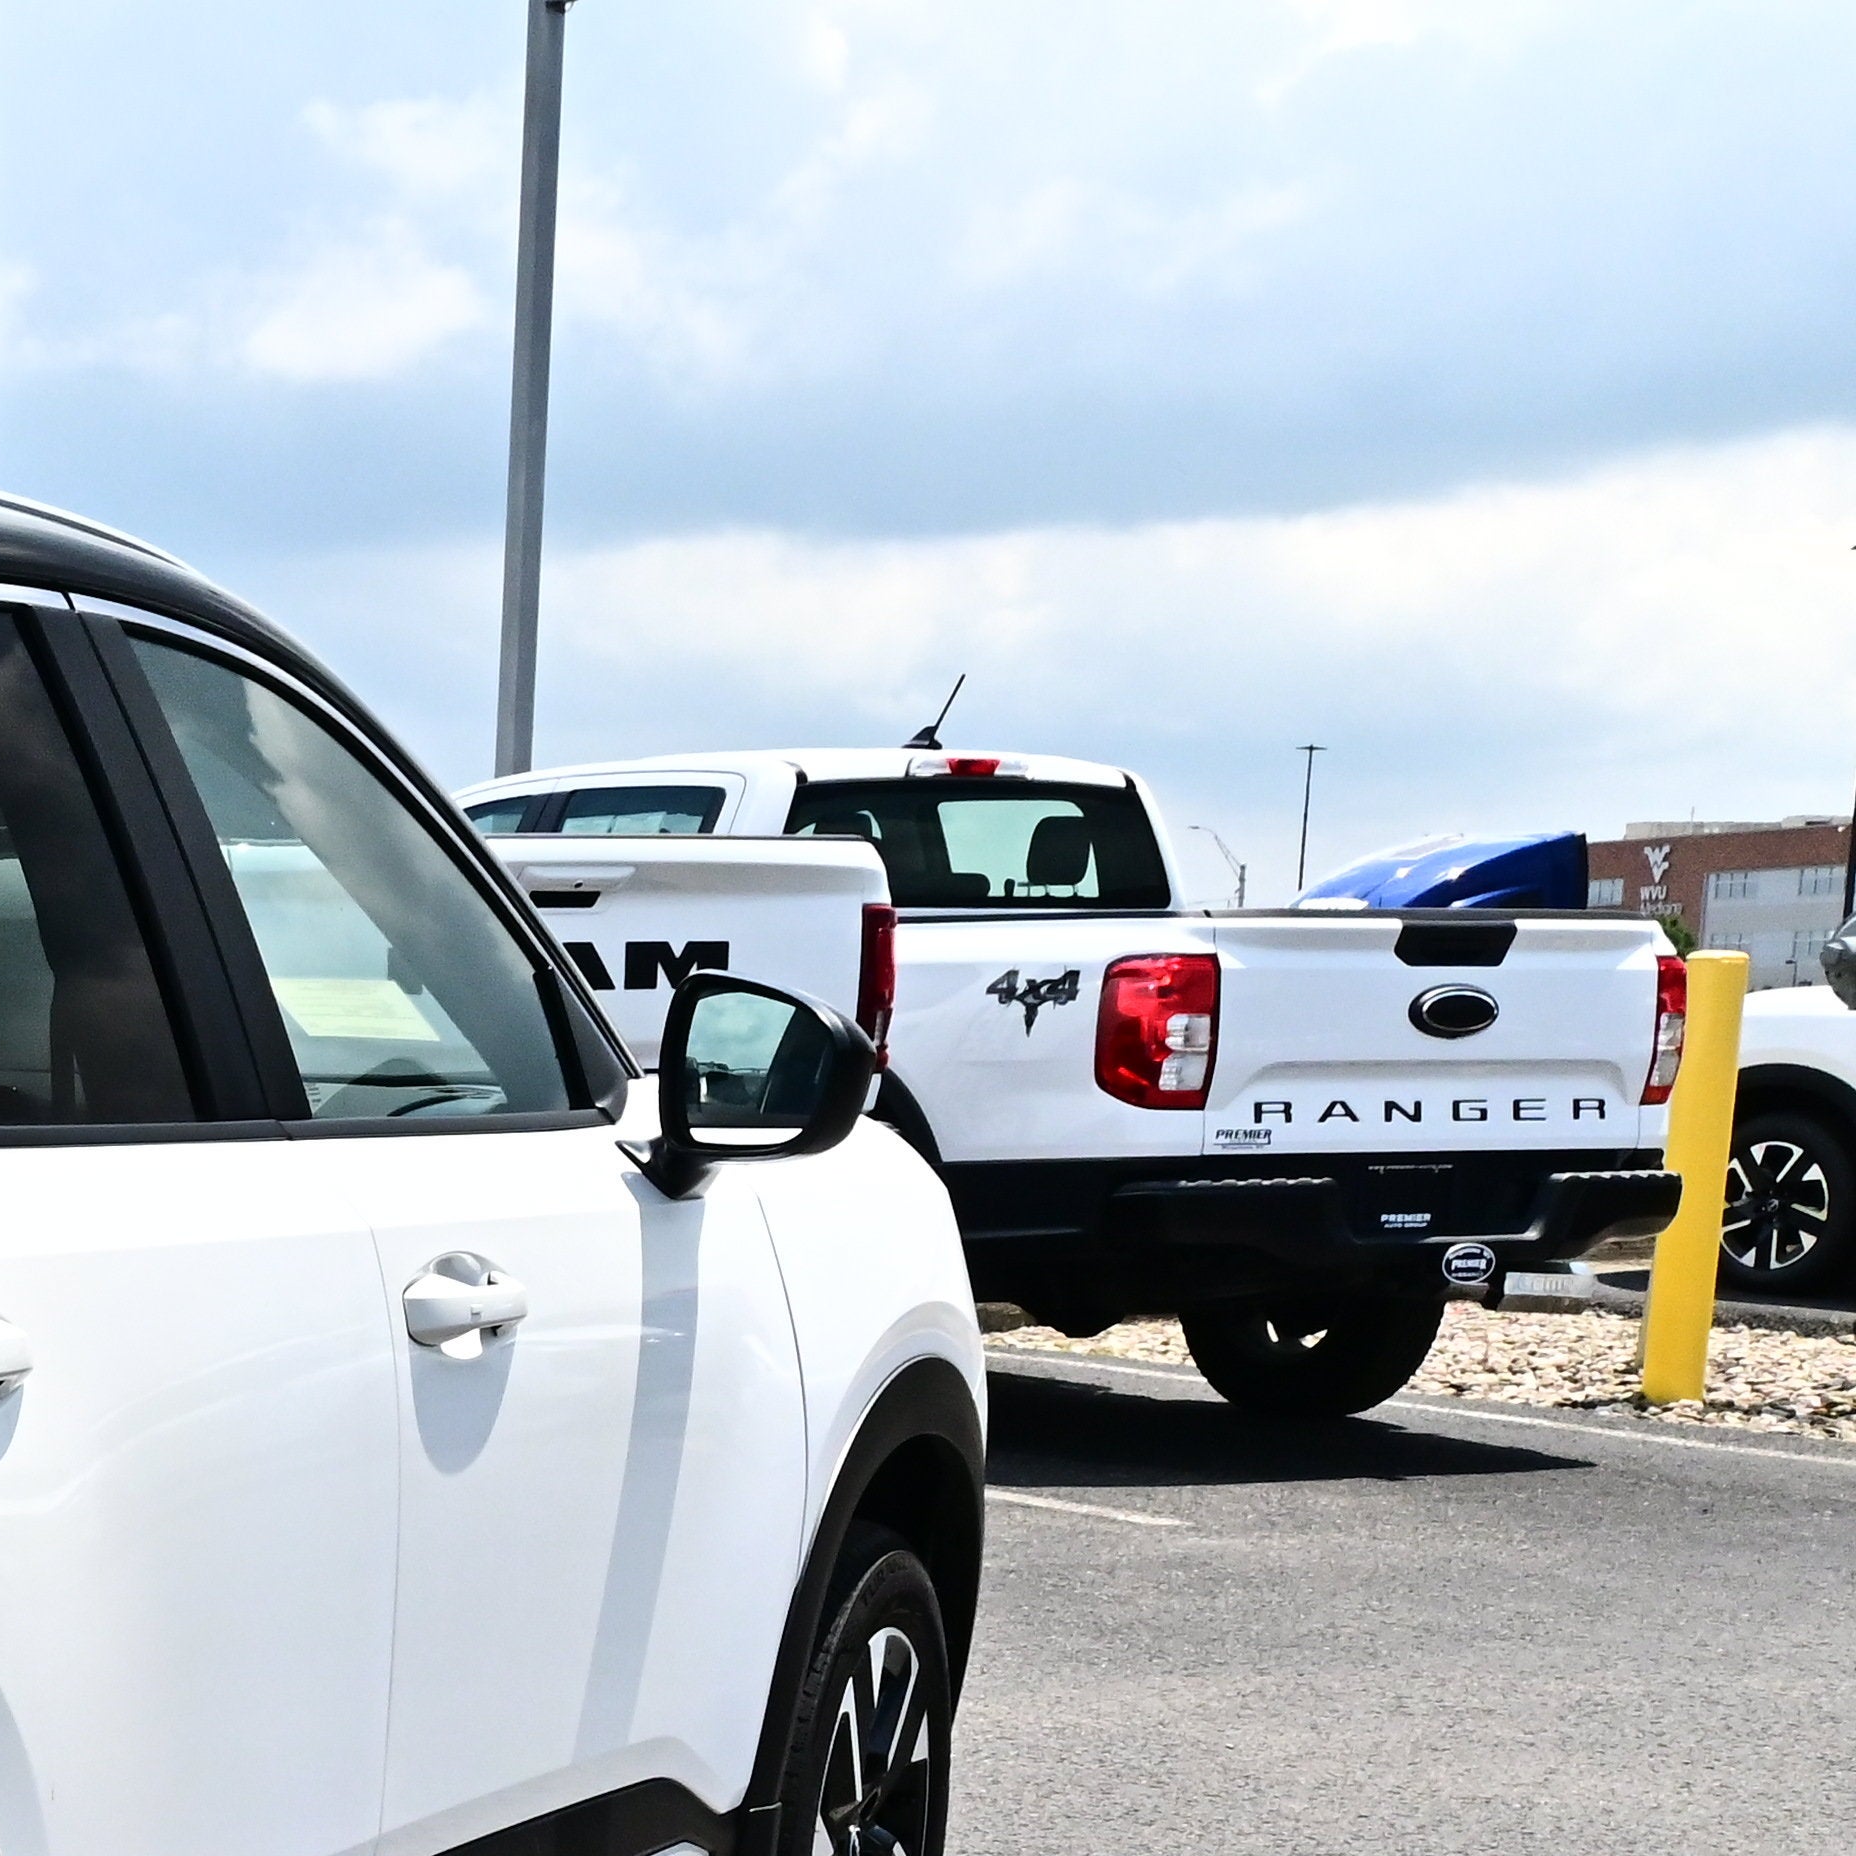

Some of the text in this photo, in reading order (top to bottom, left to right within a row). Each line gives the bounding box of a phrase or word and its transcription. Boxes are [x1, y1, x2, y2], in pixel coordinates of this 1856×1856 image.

[1640, 885, 1667, 900] WVU
[1253, 1098, 1607, 1124] RANGER
[1215, 1129, 1272, 1141] PREMIER
